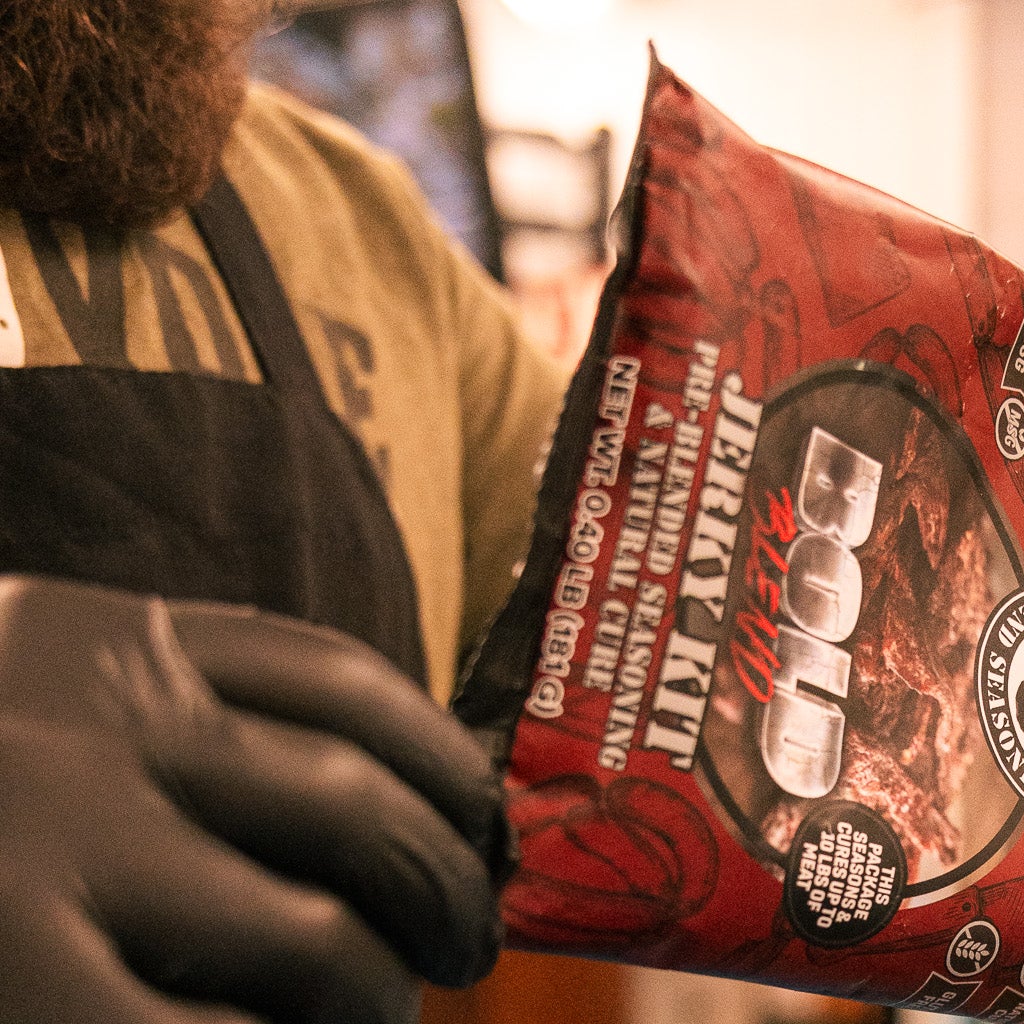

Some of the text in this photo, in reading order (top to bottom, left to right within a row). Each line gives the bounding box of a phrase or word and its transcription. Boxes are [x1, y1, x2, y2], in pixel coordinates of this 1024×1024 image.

[600, 357, 639, 425] NET
[584, 429, 623, 484] WT.
[568, 490, 610, 560] 0.40
[583, 403, 674, 692] & NATURAL CURE
[598, 341, 719, 772] PRE-BLENDED SEASONING
[556, 565, 592, 608] LB
[643, 372, 763, 771] JERKY KIT
[731, 487, 797, 703] BLEND
[761, 426, 884, 799] BOLD
[796, 842, 818, 891] MEAT
[807, 831, 835, 912] 10 LBS OF
[816, 821, 852, 929] CURES UP TO
[835, 831, 868, 923] SEASONS &
[854, 842, 883, 920] PACKAGE
[875, 867, 896, 906] THIS
